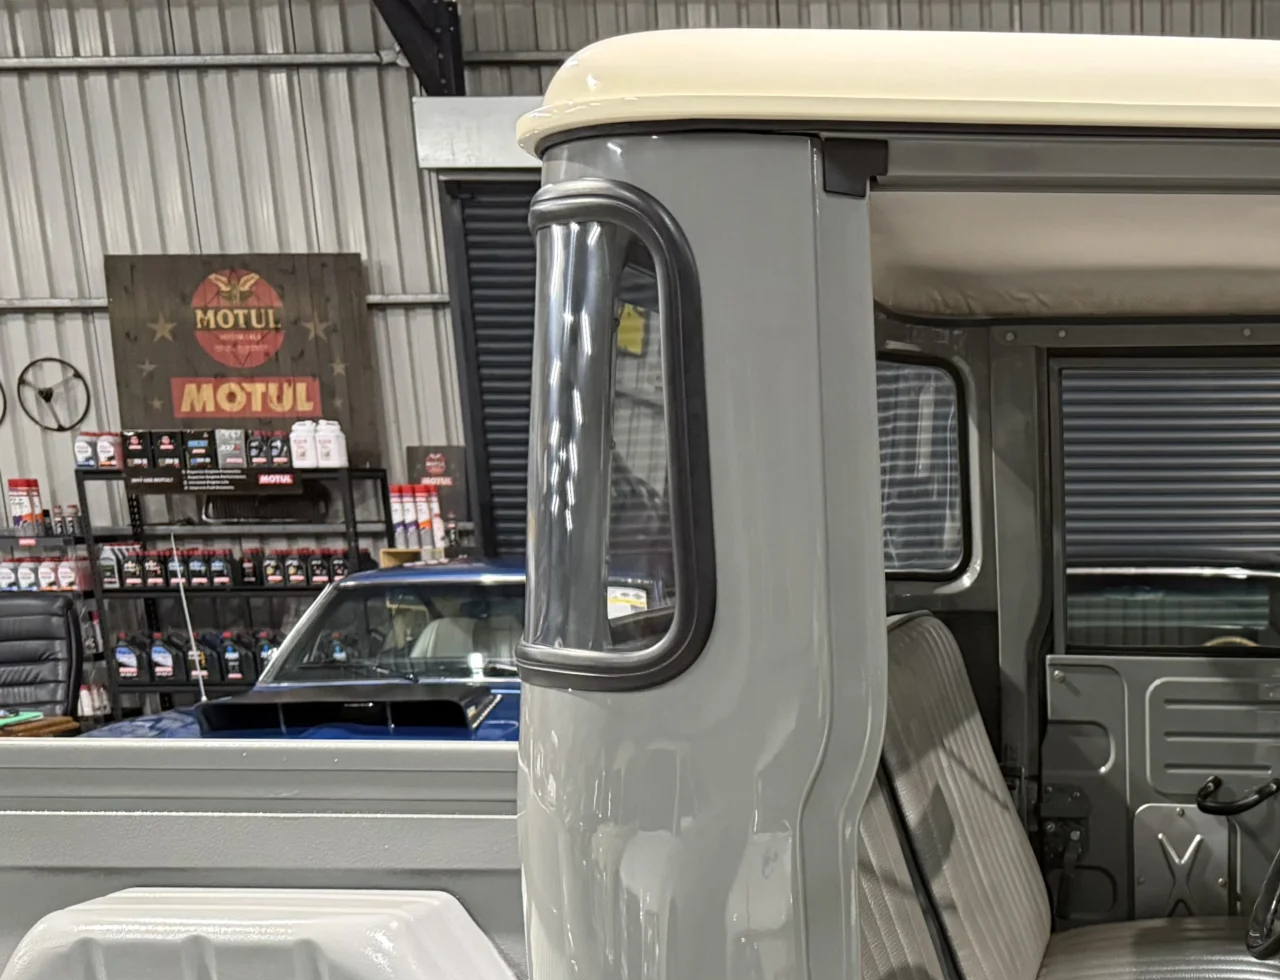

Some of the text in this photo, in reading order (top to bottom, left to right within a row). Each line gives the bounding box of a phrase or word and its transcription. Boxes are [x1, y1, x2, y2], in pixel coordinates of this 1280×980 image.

[194, 308, 281, 329] MOTUL
[181, 382, 314, 412] MOTUL
[259, 474, 294, 484] MOTUL
